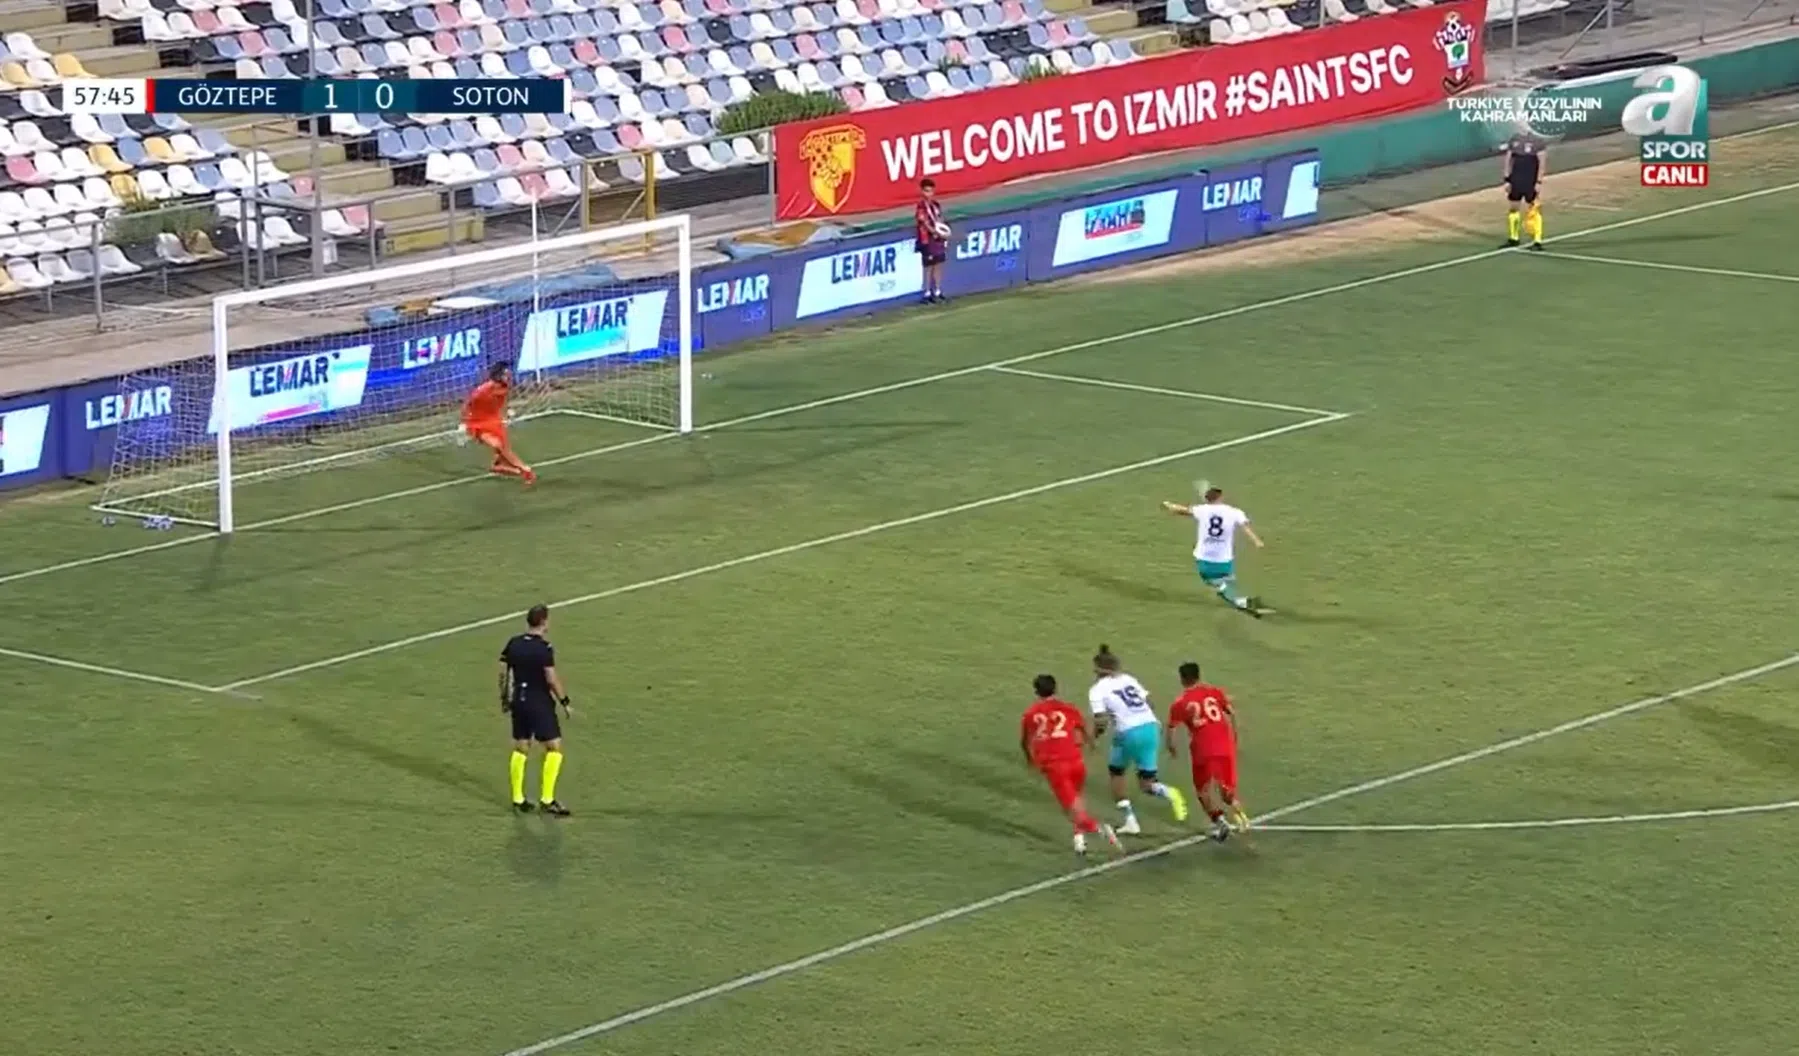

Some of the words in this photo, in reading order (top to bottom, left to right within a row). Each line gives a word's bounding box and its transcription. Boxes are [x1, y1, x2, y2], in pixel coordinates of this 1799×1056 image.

[881, 107, 1065, 182] WELCOME
[1071, 98, 1118, 145] TO
[1124, 80, 1218, 136] IZMIR
[1225, 44, 1414, 117] #SAINTSFC
[1202, 176, 1263, 211] LEMAR
[832, 247, 896, 284] LEMAR
[697, 274, 770, 312] LEMAR
[557, 300, 628, 339] LEMAR
[403, 328, 482, 369] LEMAR
[250, 355, 329, 398] LEMAR
[86, 385, 172, 430] LEMAR
[1208, 515, 1224, 537] 8
[1032, 711, 1068, 741] 22
[1185, 696, 1222, 727] 26
